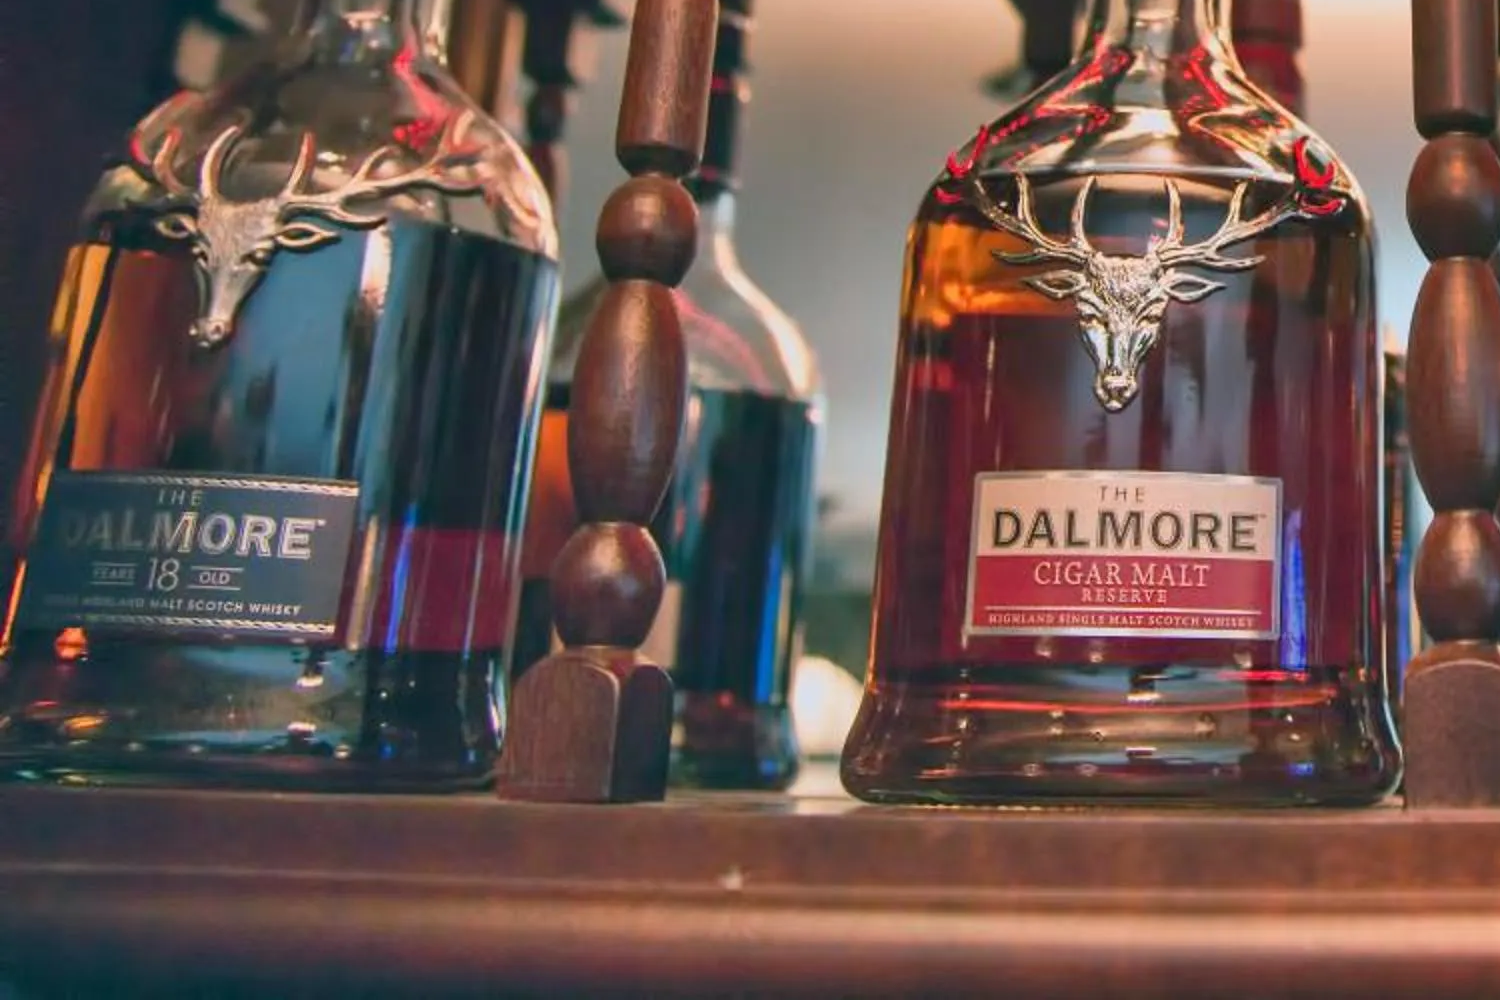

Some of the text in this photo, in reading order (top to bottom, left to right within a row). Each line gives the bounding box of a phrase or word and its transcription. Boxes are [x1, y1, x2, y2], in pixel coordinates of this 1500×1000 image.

[158, 488, 205, 505] THE
[1100, 486, 1146, 503] THE
[61, 509, 318, 561] DALMORE
[992, 508, 1258, 552] DALMORE
[148, 556, 181, 591] 18
[198, 571, 231, 585] OLD
[1034, 560, 1211, 587] CIGAR MALT
[1081, 587, 1168, 604] RESERVE
[150, 597, 183, 611] MALT
[187, 599, 244, 614] SCOTCH
[249, 602, 302, 616] WHISKY
[988, 612, 1256, 629] HIGHLAND SINGLE MALT SCOTCH WHISKY
